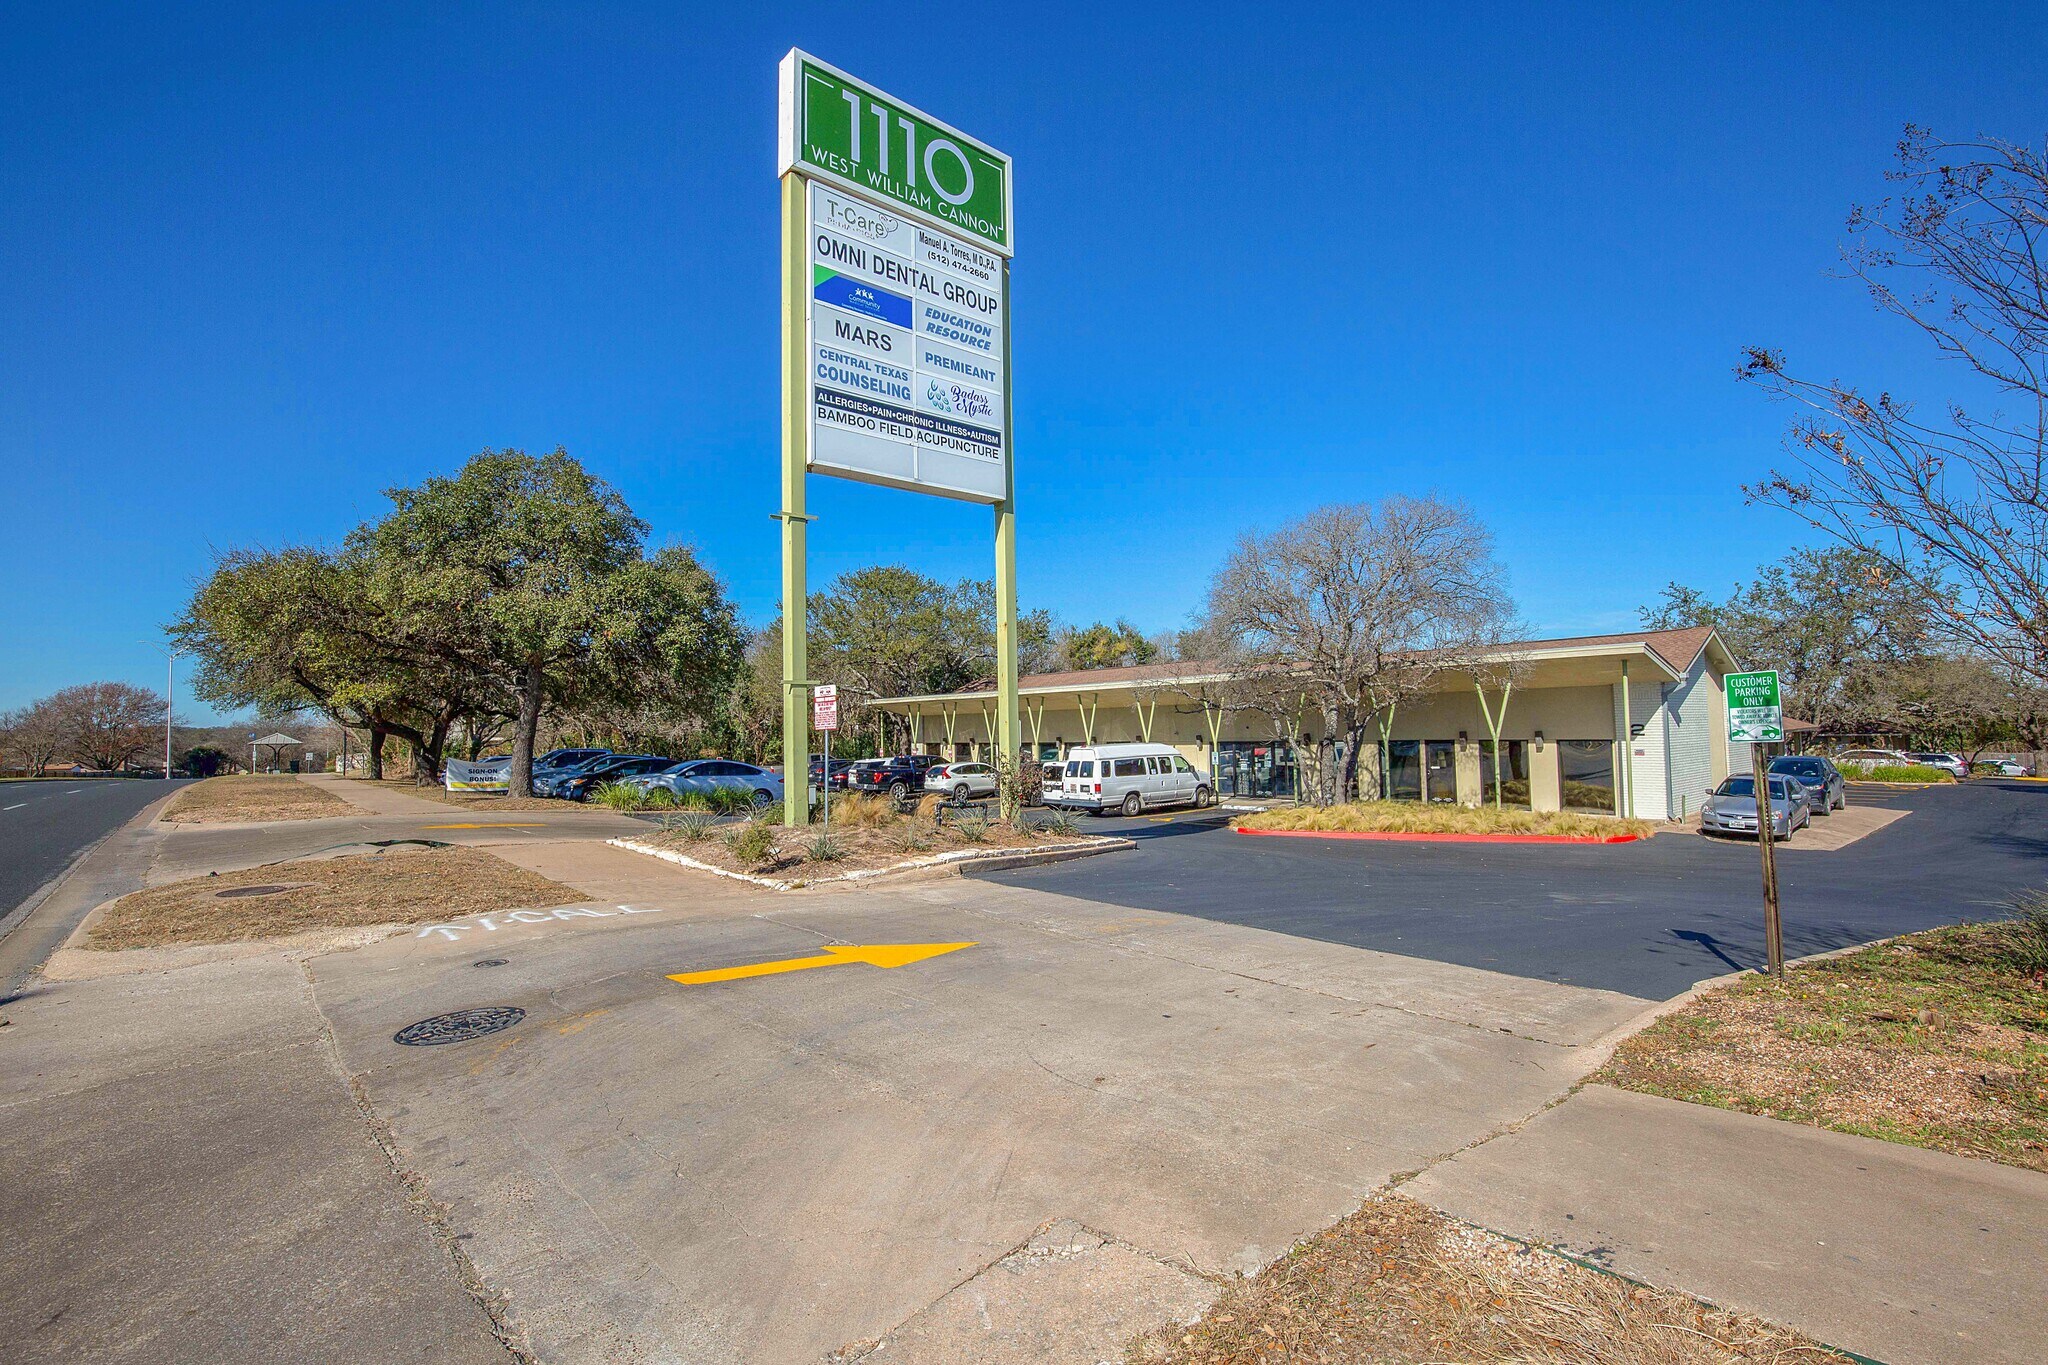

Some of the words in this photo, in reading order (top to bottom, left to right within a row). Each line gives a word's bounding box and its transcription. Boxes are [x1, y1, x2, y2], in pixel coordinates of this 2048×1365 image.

[842, 88, 975, 206] 1110
[810, 144, 859, 178] WEST
[866, 168, 931, 210] WILLIAM
[937, 201, 999, 239] CANNON
[826, 198, 884, 237] T-Care
[918, 230, 942, 251] Manuel
[816, 234, 867, 270] OMNI
[872, 256, 940, 297] DENTAL
[943, 281, 998, 315] GROUP
[927, 250, 950, 267] (512)
[951, 260, 990, 281] 474-2660
[848, 293, 881, 310] Community
[835, 319, 892, 352] MARS
[924, 307, 992, 338] EDUCATION
[925, 321, 992, 351] RESOURCE
[819, 348, 872, 372] CENTRAL
[874, 363, 909, 382] TEXAS
[924, 351, 996, 383] PREMIEANT
[816, 363, 911, 401] COUNSELING
[950, 384, 989, 404] Badass
[956, 398, 994, 418] Mystic
[817, 406, 876, 431] BAMBOO
[880, 421, 914, 439] FIELD
[916, 430, 999, 460] ACUPUNCTURE
[1730, 676, 1773, 688] CUSTOMER
[1734, 686, 1771, 697] PARKING
[1743, 697, 1764, 706] ONLY
[1630, 723, 1646, 736] 2
